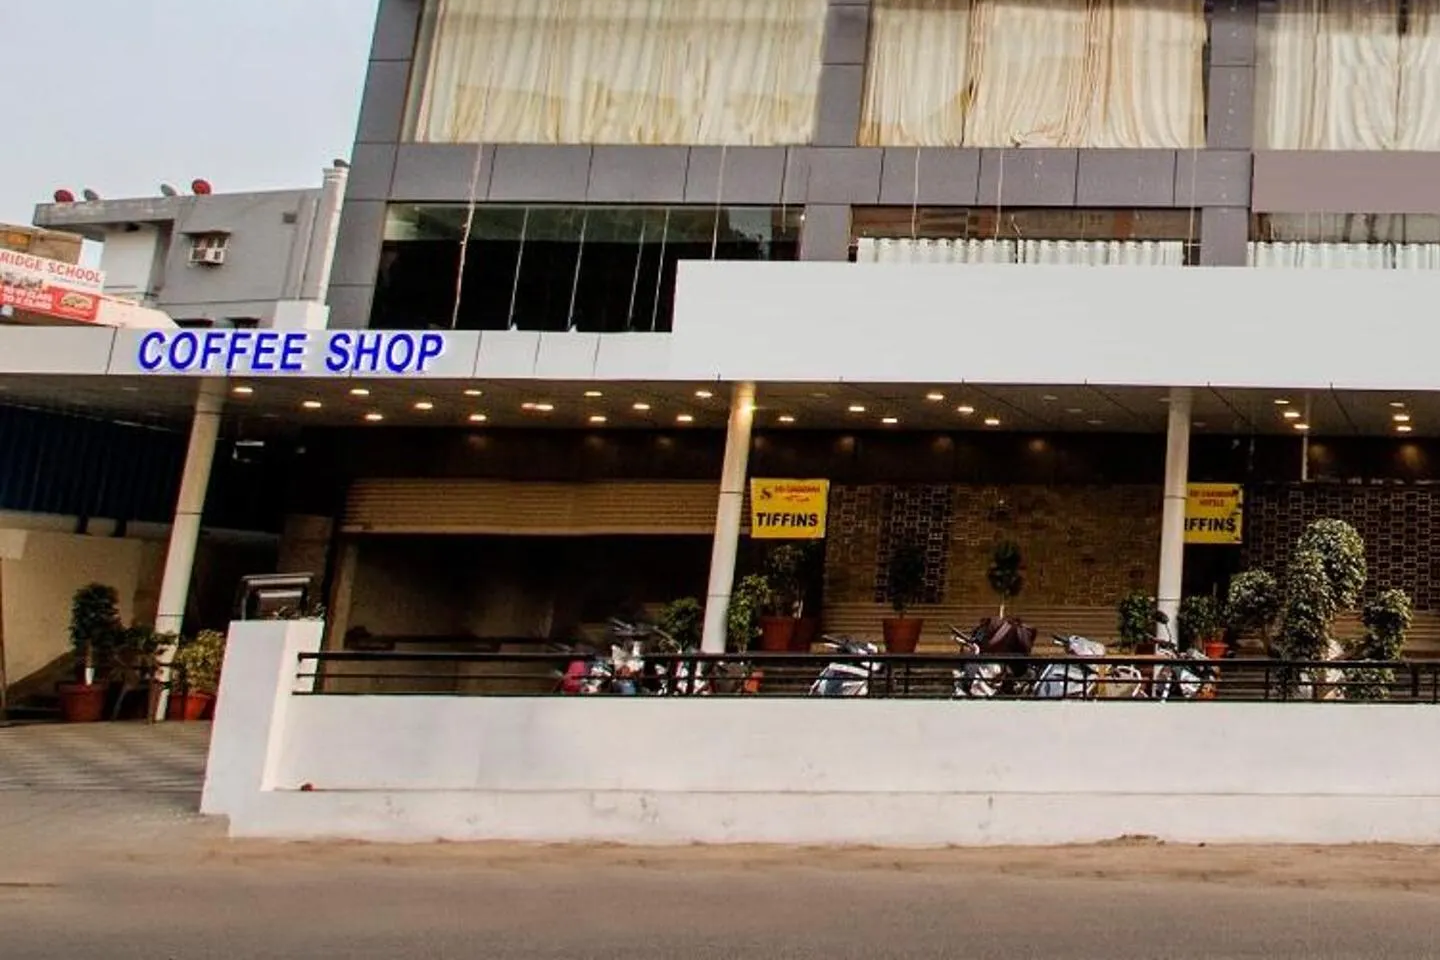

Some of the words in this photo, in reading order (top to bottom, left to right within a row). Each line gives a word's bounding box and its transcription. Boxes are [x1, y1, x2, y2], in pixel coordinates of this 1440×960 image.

[48, 262, 102, 283] SCHOOL
[138, 331, 307, 371] COFFEE
[326, 333, 444, 373] SHOP
[757, 512, 819, 527] TIFFINS
[1182, 517, 1236, 532] IFFINS
